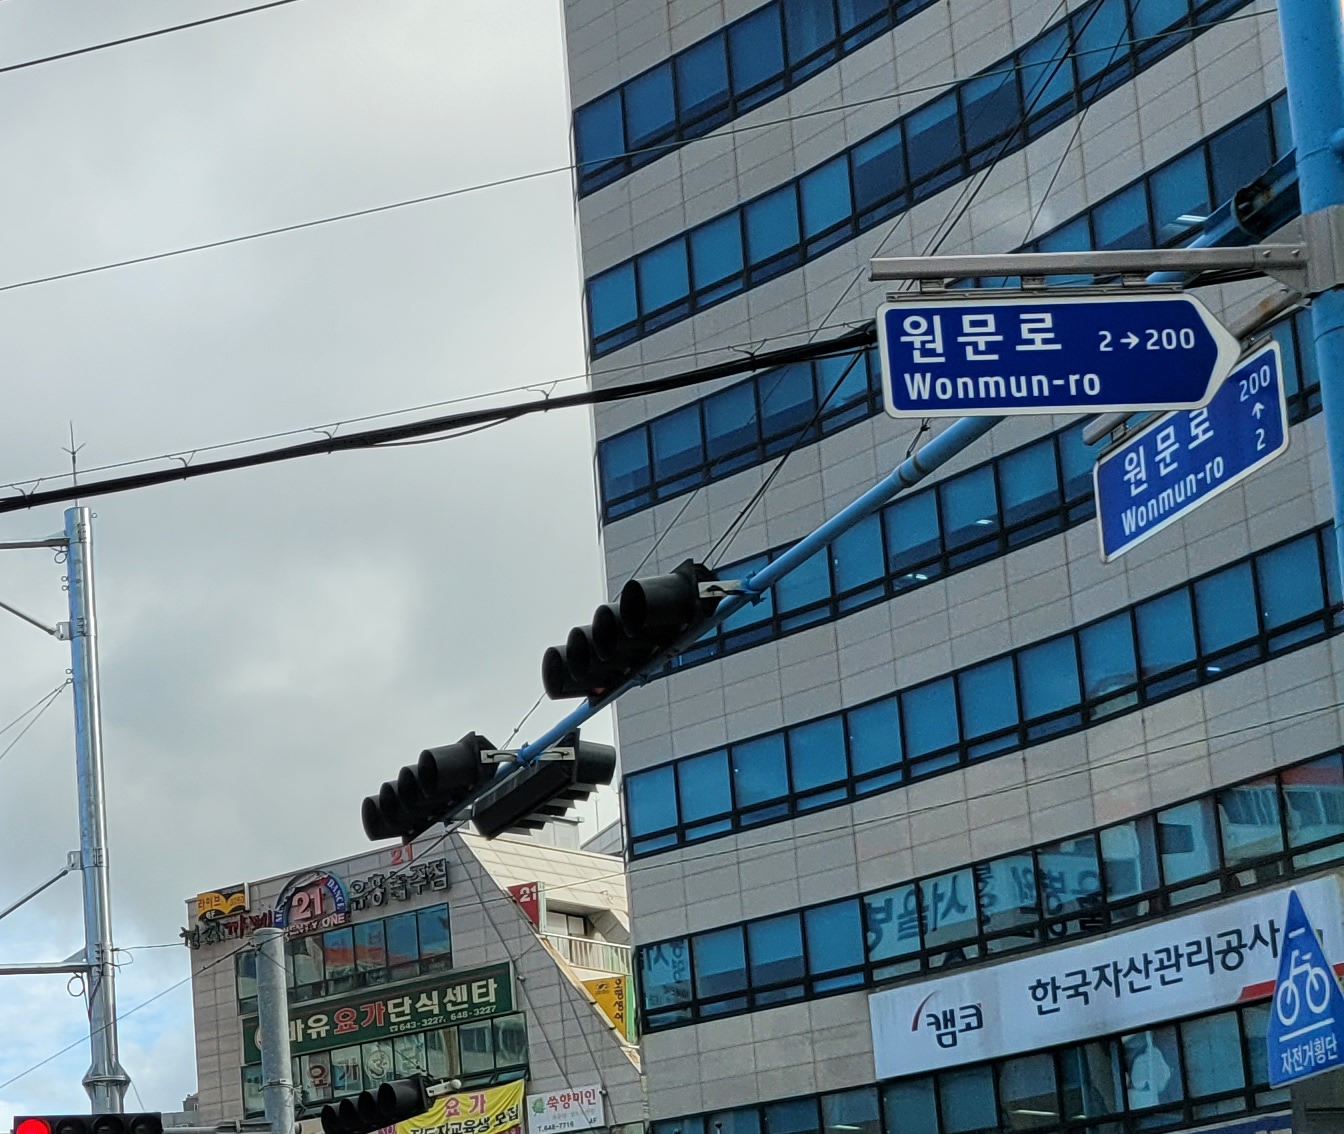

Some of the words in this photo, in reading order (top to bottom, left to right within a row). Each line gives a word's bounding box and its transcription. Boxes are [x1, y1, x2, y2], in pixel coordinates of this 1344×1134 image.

[901, 313, 1062, 363] 원문로
[1145, 328, 1194, 349] 200
[904, 372, 1100, 400] Wonmun-ro
[1239, 365, 1270, 401] 200
[1123, 407, 1214, 496] 원문로
[1121, 456, 1224, 538] Wonmun-ro
[292, 888, 324, 920] 21
[1029, 920, 1280, 1015] 한국자산관리공사
[926, 1003, 983, 1048] 캠코
[1281, 1037, 1338, 1076] 자전거횡단
